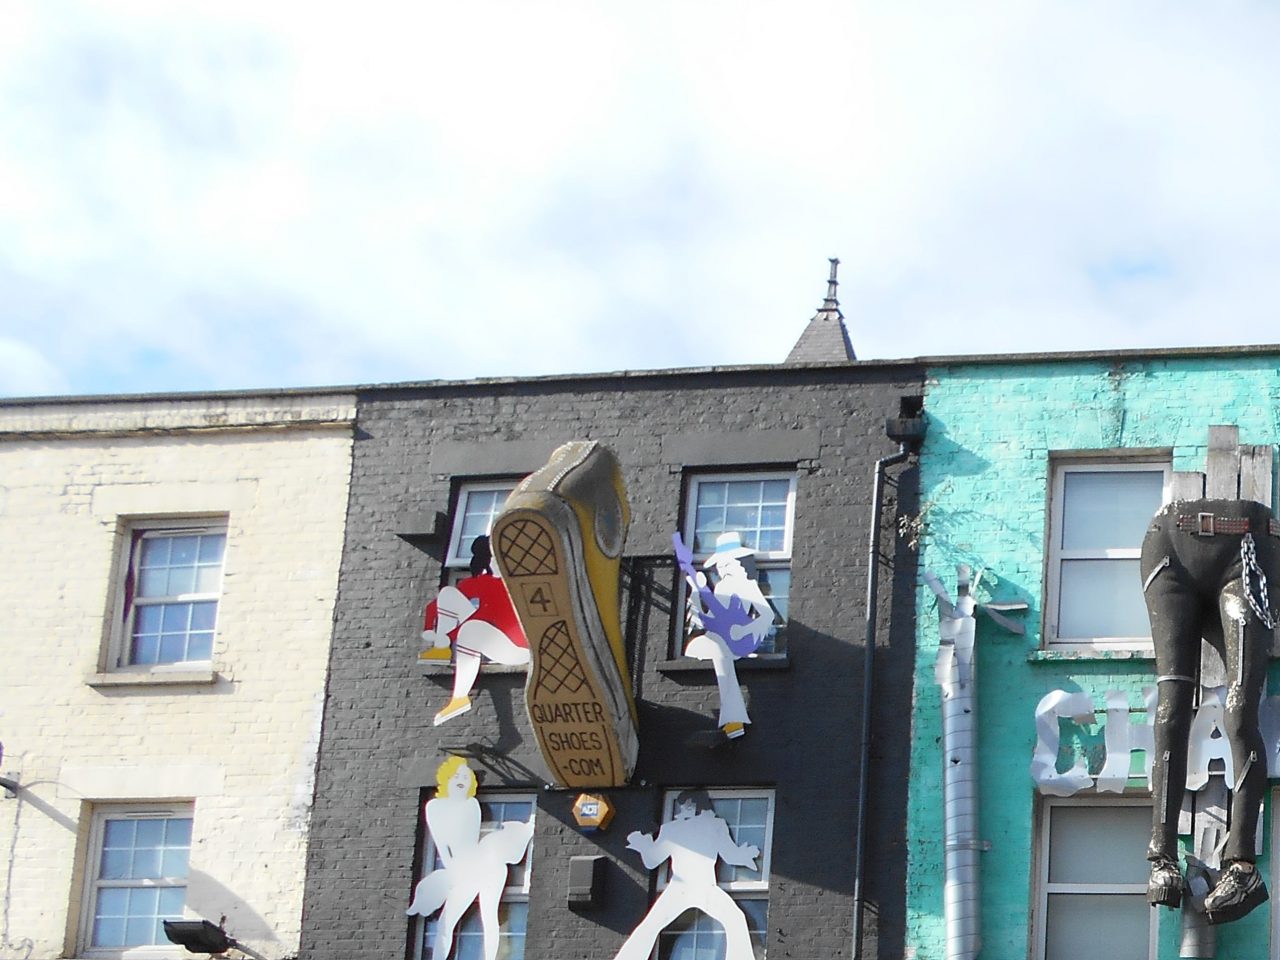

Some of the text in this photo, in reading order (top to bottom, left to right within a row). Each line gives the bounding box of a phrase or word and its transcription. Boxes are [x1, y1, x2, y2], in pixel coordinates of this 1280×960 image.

[529, 586, 551, 613] 4
[532, 701, 605, 724] QUARTER
[549, 731, 603, 751] SHOES
